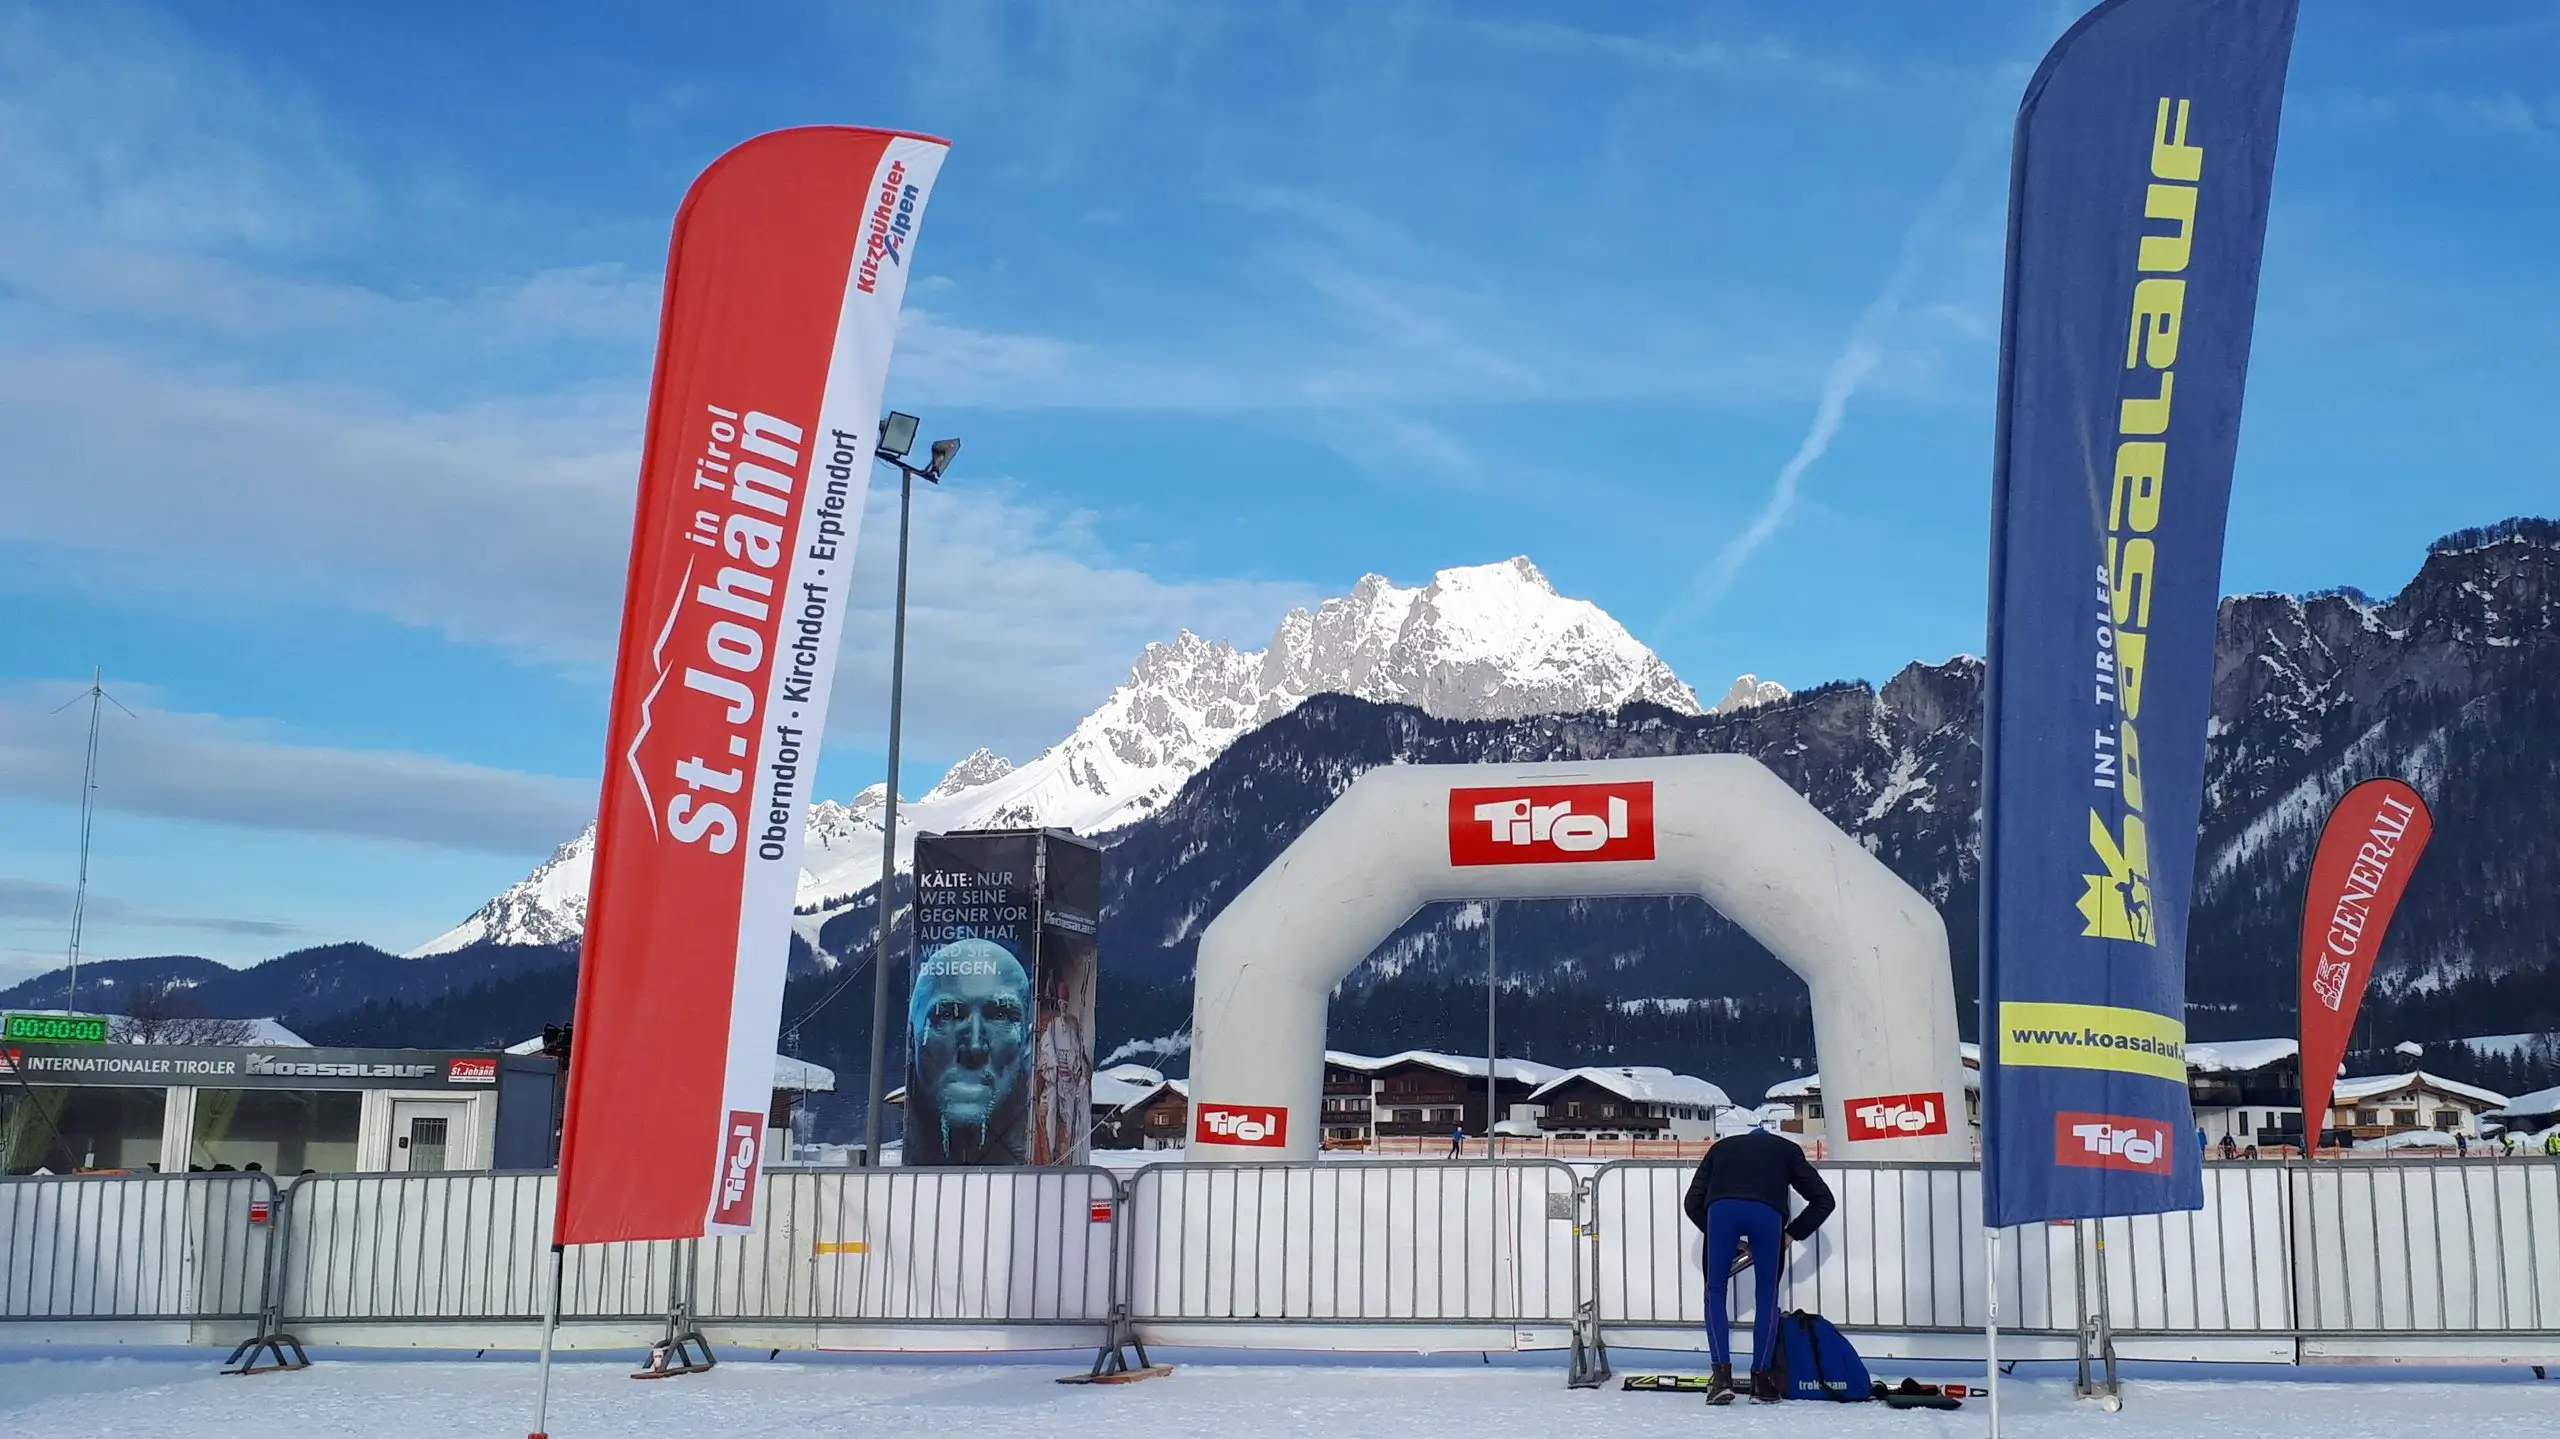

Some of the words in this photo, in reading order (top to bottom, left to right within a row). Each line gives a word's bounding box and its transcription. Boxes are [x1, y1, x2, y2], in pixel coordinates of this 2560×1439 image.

[857, 160, 906, 294] Kitzbüheler
[884, 184, 919, 267] Alpen
[693, 404, 741, 492] Tirol
[685, 510, 721, 548] in
[759, 725, 803, 860] Oberndorf
[783, 582, 829, 703] Kirchdorf
[810, 429, 858, 561] Erpfendorf
[2095, 564, 2116, 705] TIROLER
[2094, 723, 2116, 788] INT.
[1474, 795, 1628, 851] Tirol
[920, 870, 973, 887] KÄLTE:
[977, 872, 1013, 886] NUR
[2327, 794, 2415, 956] GENERALI
[920, 891, 956, 905] WER
[962, 889, 1006, 904] SEINE
[920, 908, 989, 923] GEGNER
[992, 906, 1028, 921] VOR
[920, 925, 979, 940] AUGEN
[984, 924, 1019, 941] HAT,
[920, 943, 961, 958] WIRD
[967, 944, 990, 958] SIE
[920, 961, 1001, 977] BESIEGEN.
[12, 1018, 102, 1040] 00:00:00
[27, 1056, 170, 1073] INTERNATIONALER
[174, 1060, 235, 1075] TIROLER
[1204, 1111, 1276, 1140] Tirol
[1855, 1100, 1936, 1131] Tirol
[2072, 1124, 2163, 1164] Tirol
[723, 1125, 755, 1210] Tirol
